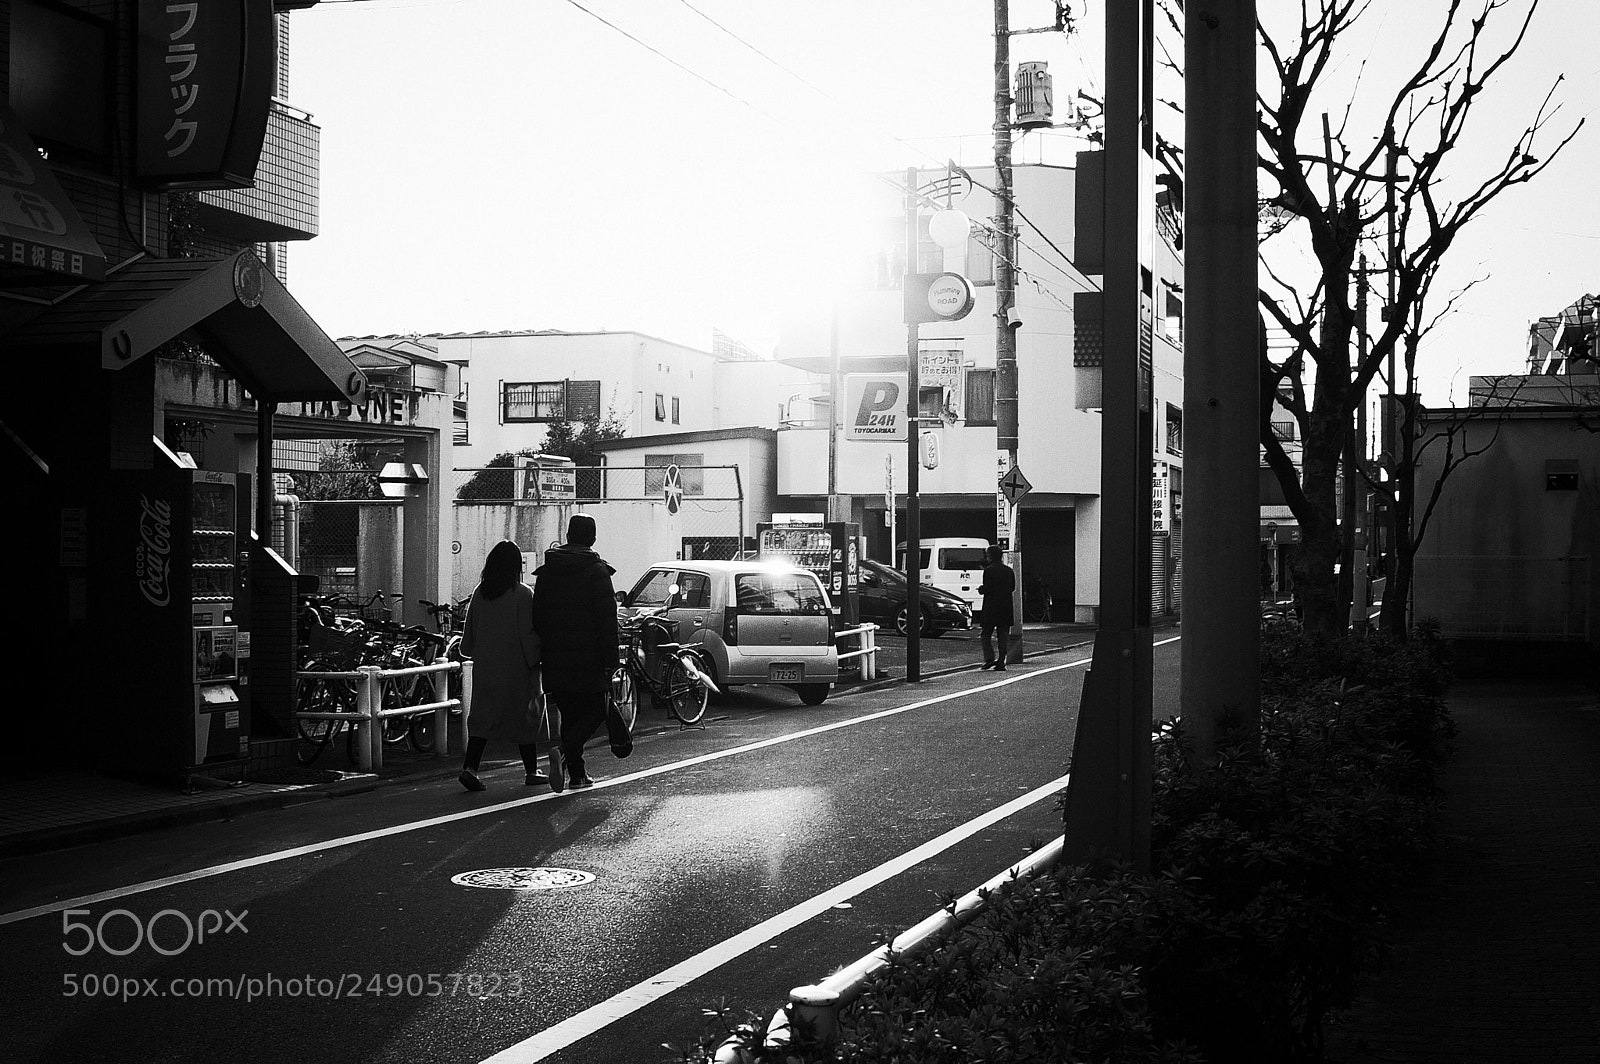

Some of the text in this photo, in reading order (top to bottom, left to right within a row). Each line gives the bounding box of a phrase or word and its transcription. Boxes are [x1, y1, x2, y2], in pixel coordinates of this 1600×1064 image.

[937, 297, 958, 305] ROAD
[855, 382, 900, 427] P
[869, 414, 896, 426] 24H
